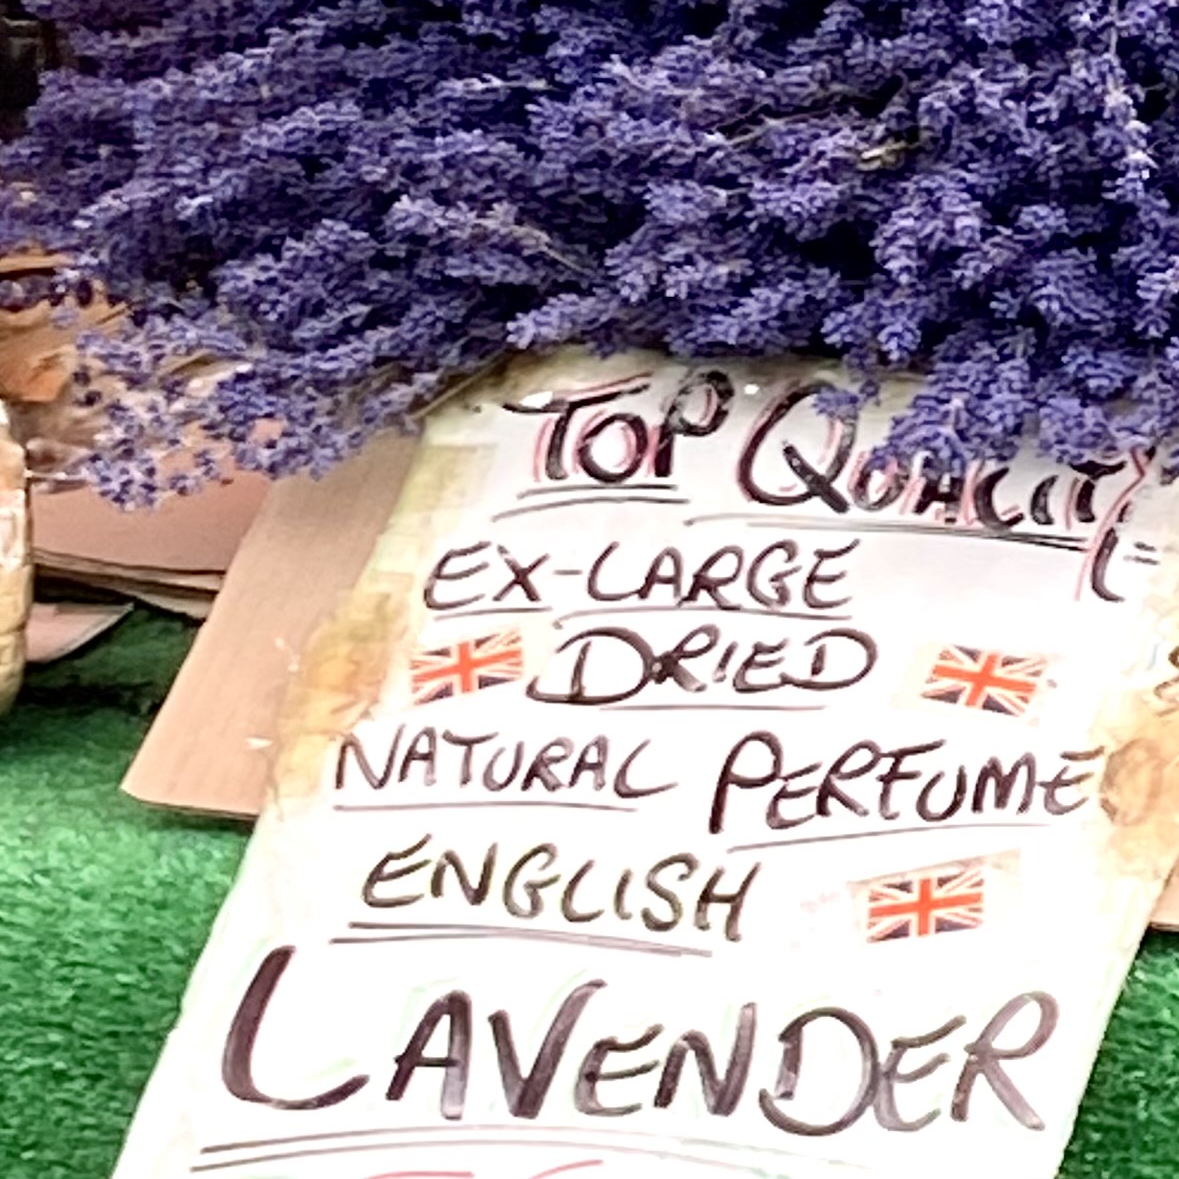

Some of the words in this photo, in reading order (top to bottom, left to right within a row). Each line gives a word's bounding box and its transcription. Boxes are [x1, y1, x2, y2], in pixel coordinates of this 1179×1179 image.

[503, 367, 734, 484] TOP
[422, 539, 860, 611] EX-LARGE
[526, 623, 878, 705] DRIED
[333, 724, 678, 798] NATURAL
[708, 729, 1106, 835] PERFUME
[360, 832, 764, 945] ENGLISH
[220, 944, 1060, 1137] LAVENDER
